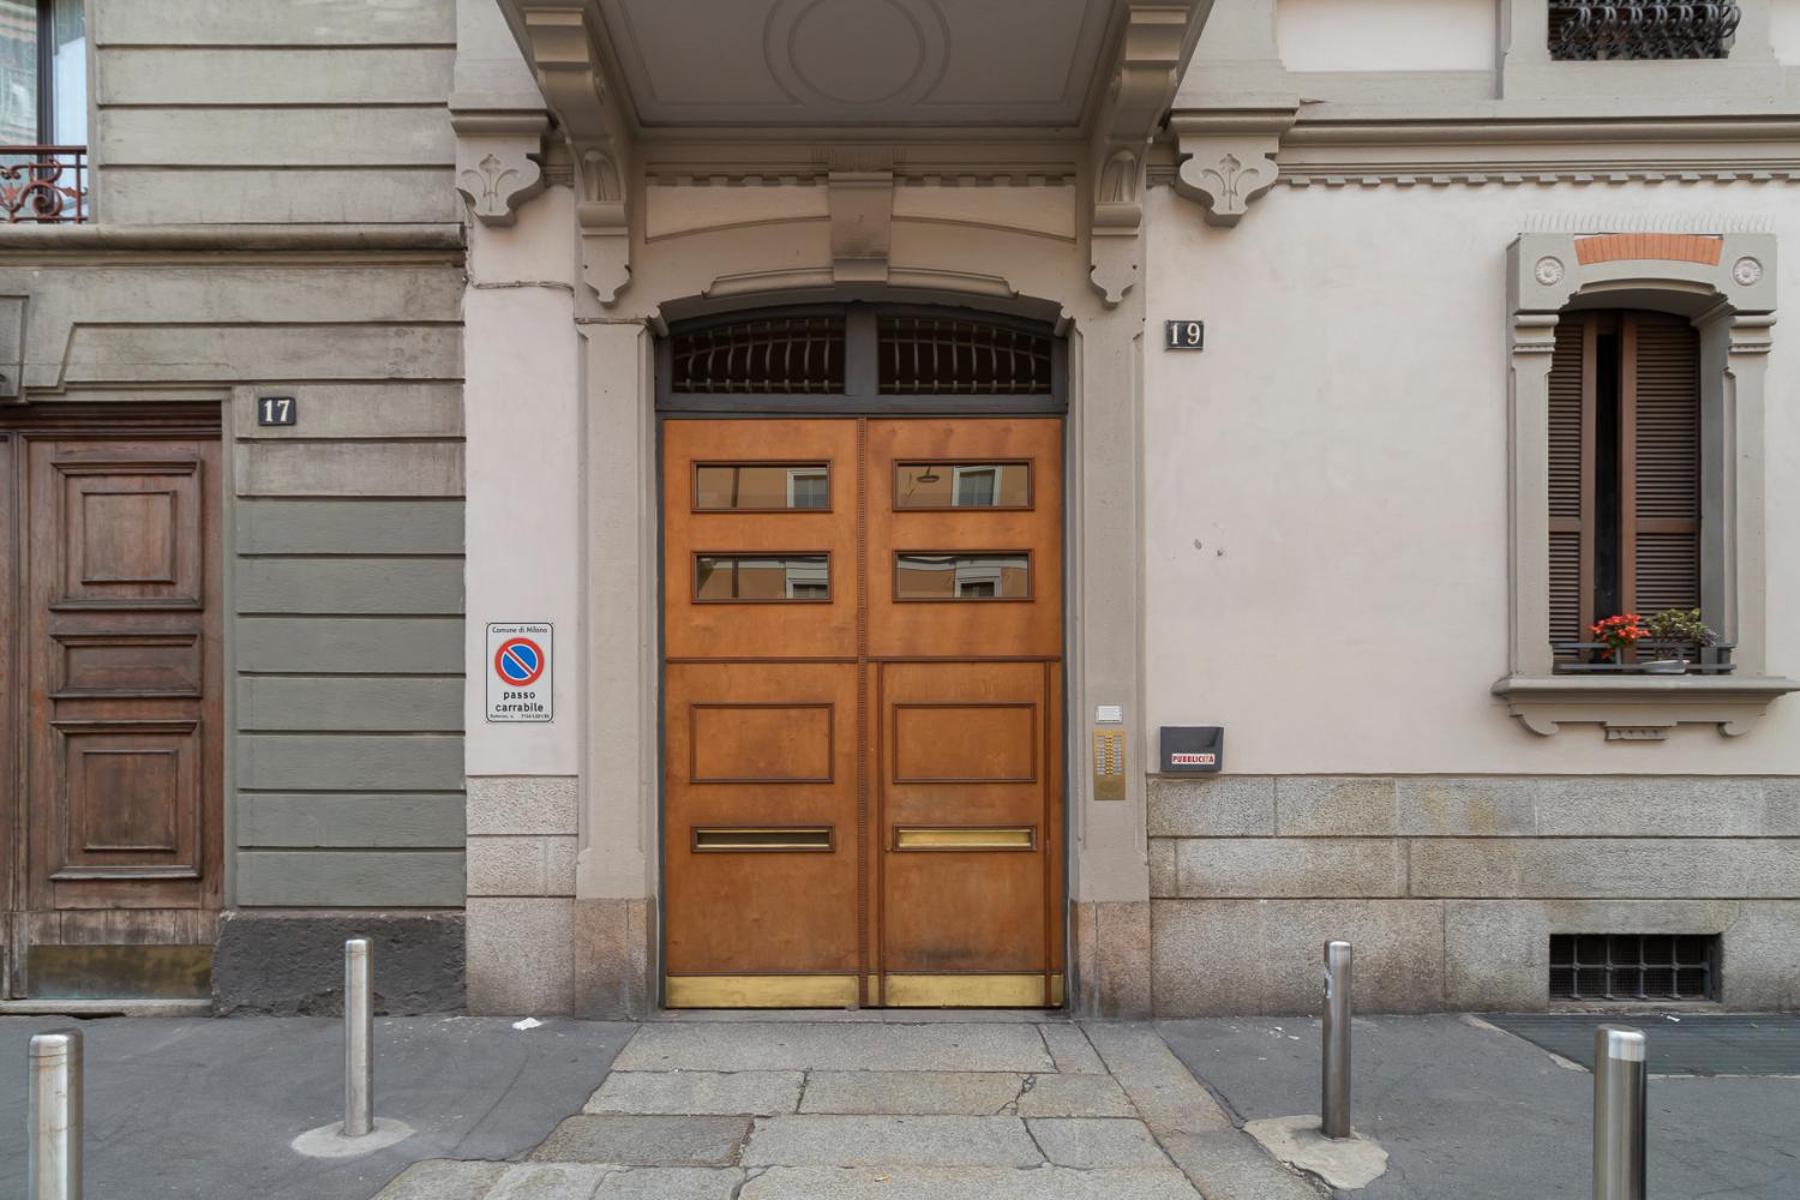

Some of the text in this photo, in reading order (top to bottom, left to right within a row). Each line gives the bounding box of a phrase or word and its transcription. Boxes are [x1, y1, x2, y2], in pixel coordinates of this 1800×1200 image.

[1171, 323, 1200, 344] 19
[264, 400, 290, 421] 17
[526, 625, 548, 633] Milano
[504, 691, 536, 700] passo
[495, 702, 544, 712] carrabile
